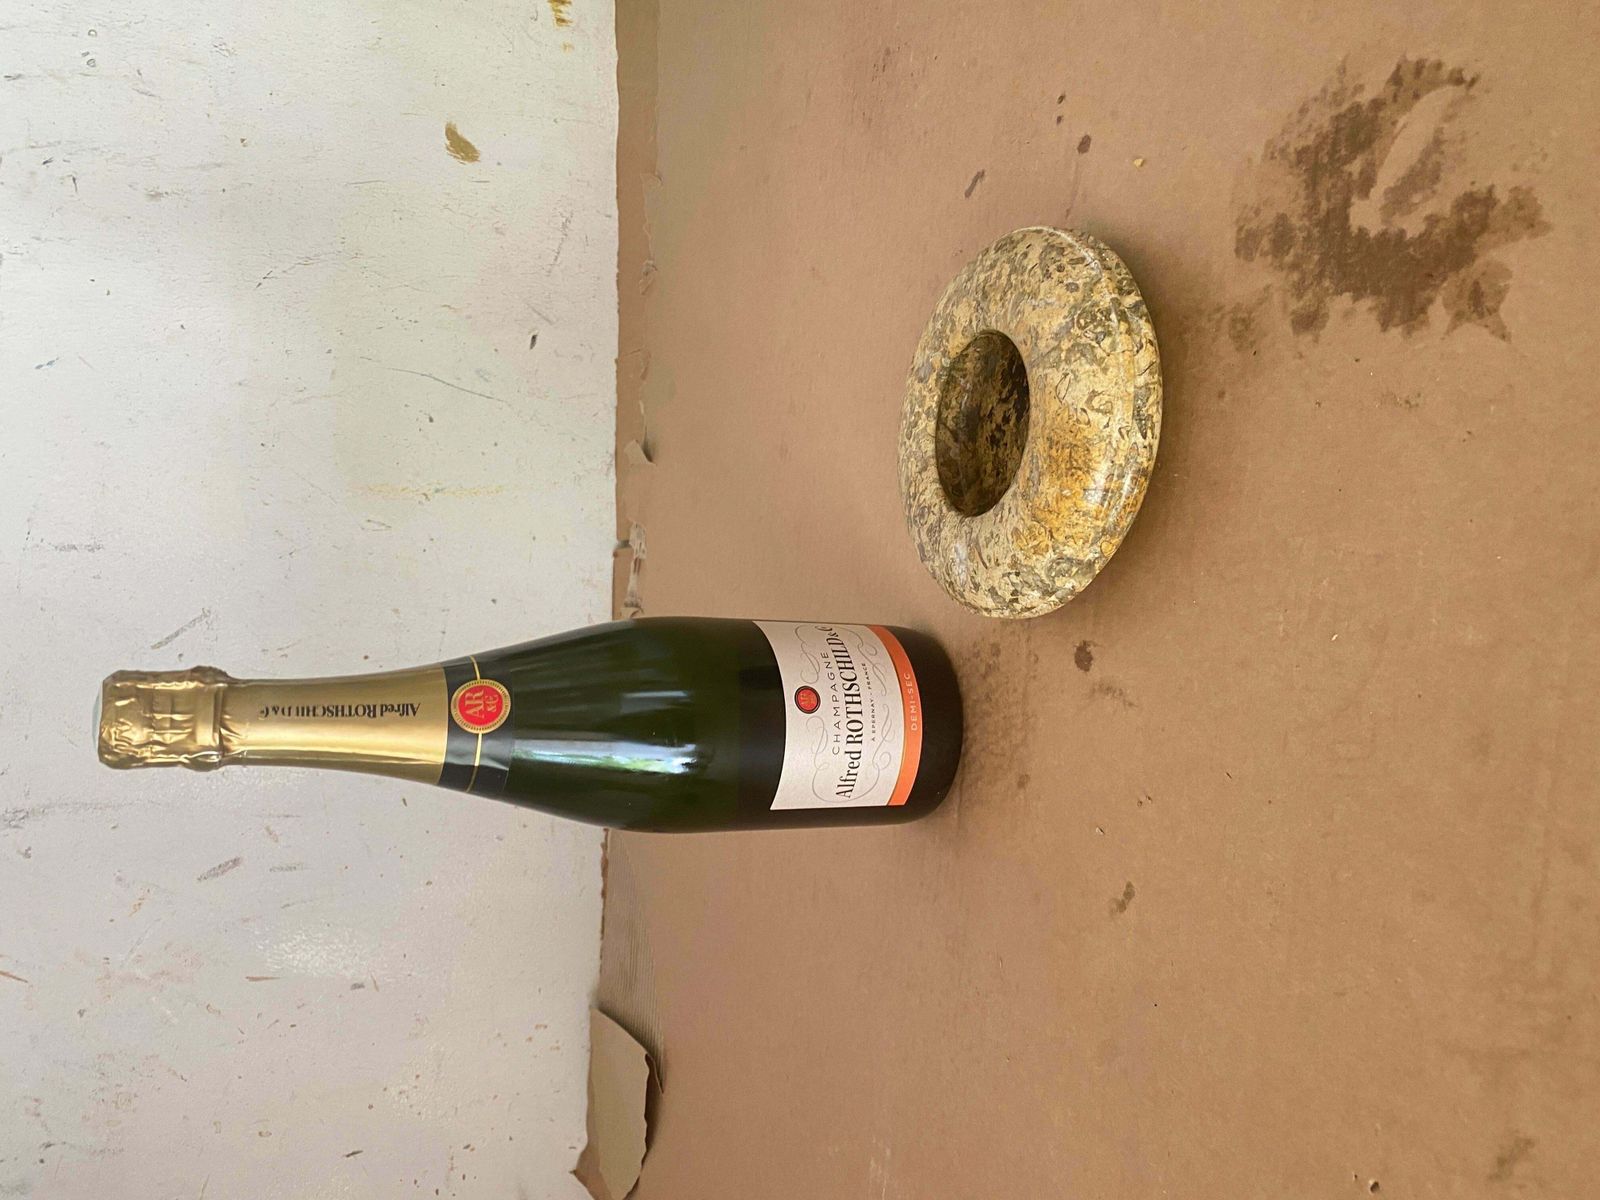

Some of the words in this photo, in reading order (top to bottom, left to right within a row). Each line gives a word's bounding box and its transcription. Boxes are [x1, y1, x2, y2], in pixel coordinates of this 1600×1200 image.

[861, 662, 873, 690] FRANCE
[380, 702, 421, 718] Alfred
[464, 689, 484, 719] AR
[820, 651, 842, 756] CHAMPAGNE
[903, 672, 918, 731] DEMI-SEC
[835, 749, 862, 799] Alfred
